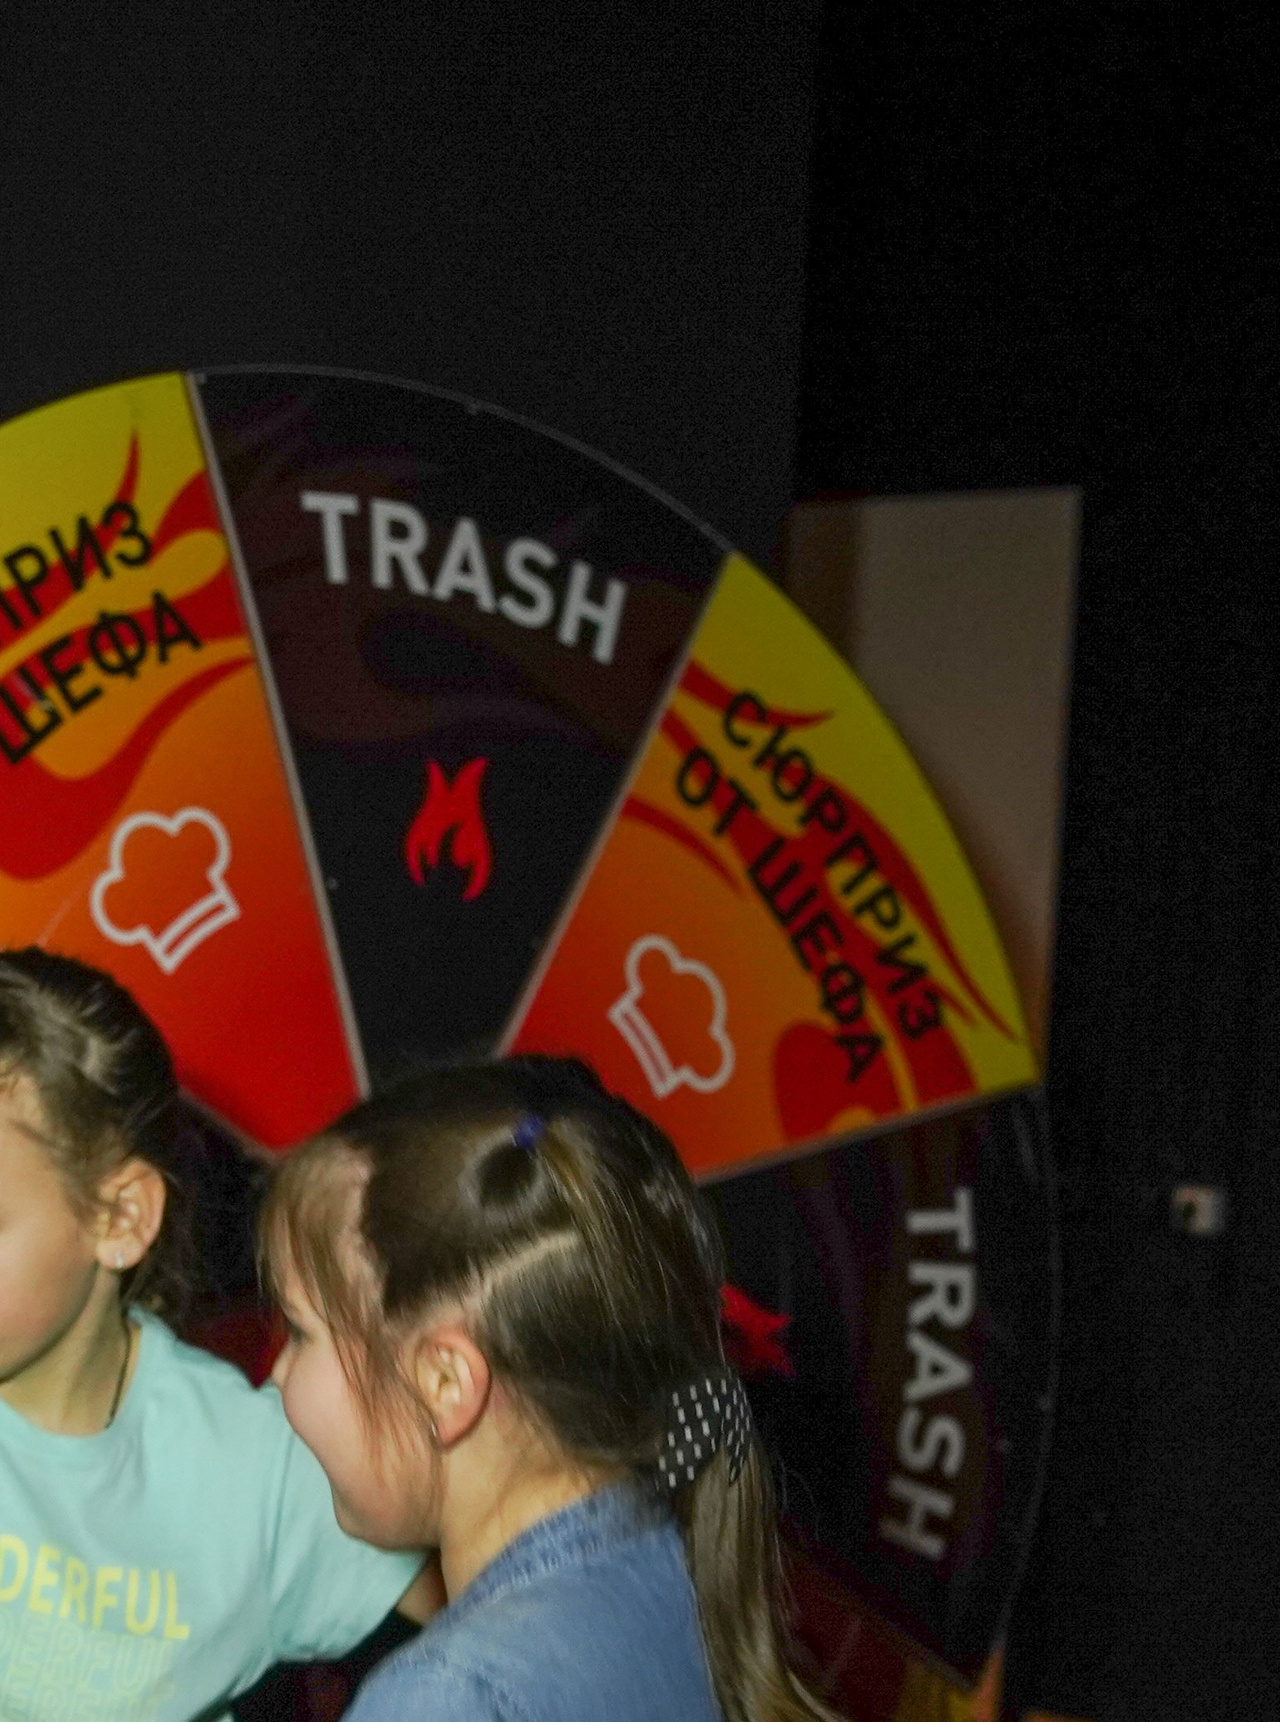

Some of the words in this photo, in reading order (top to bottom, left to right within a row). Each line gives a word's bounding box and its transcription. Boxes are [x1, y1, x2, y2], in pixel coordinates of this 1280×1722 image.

[301, 490, 627, 665] TRASH
[676, 746, 760, 837] ОТ
[747, 837, 885, 1084] ШЕФА
[723, 691, 945, 1041] СЮРПРИЗ
[877, 1187, 977, 1561] TRASH
